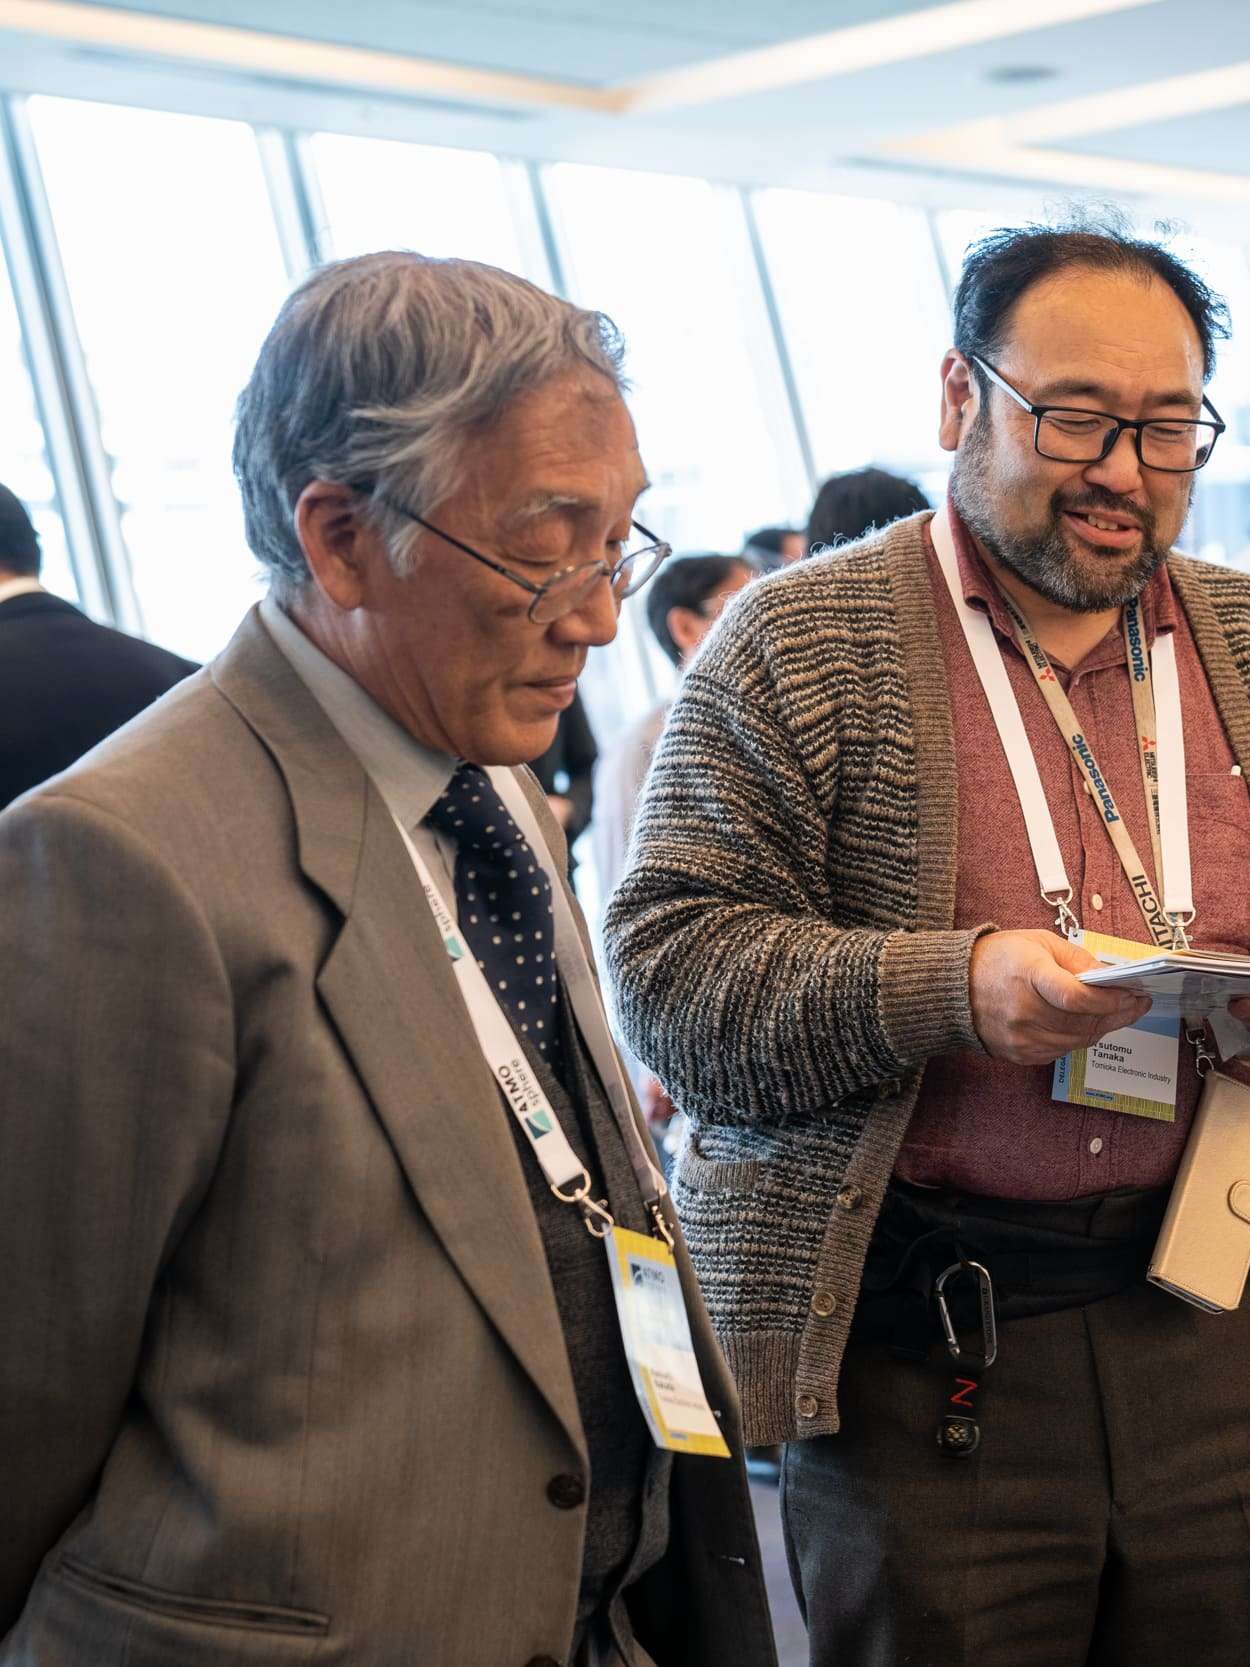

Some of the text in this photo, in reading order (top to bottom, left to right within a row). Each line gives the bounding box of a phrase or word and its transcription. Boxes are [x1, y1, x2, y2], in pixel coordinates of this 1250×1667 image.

[1126, 596, 1150, 683] Panasonic
[1071, 733, 1120, 824] Panasonic
[1131, 874, 1174, 948] ITACHI
[1092, 1048, 1125, 1063] Tanaka
[1117, 1065, 1147, 1079] Electronic
[1147, 1070, 1172, 1085] Industry
[497, 1064, 528, 1113] ATMO
[510, 1058, 540, 1107] sphere
